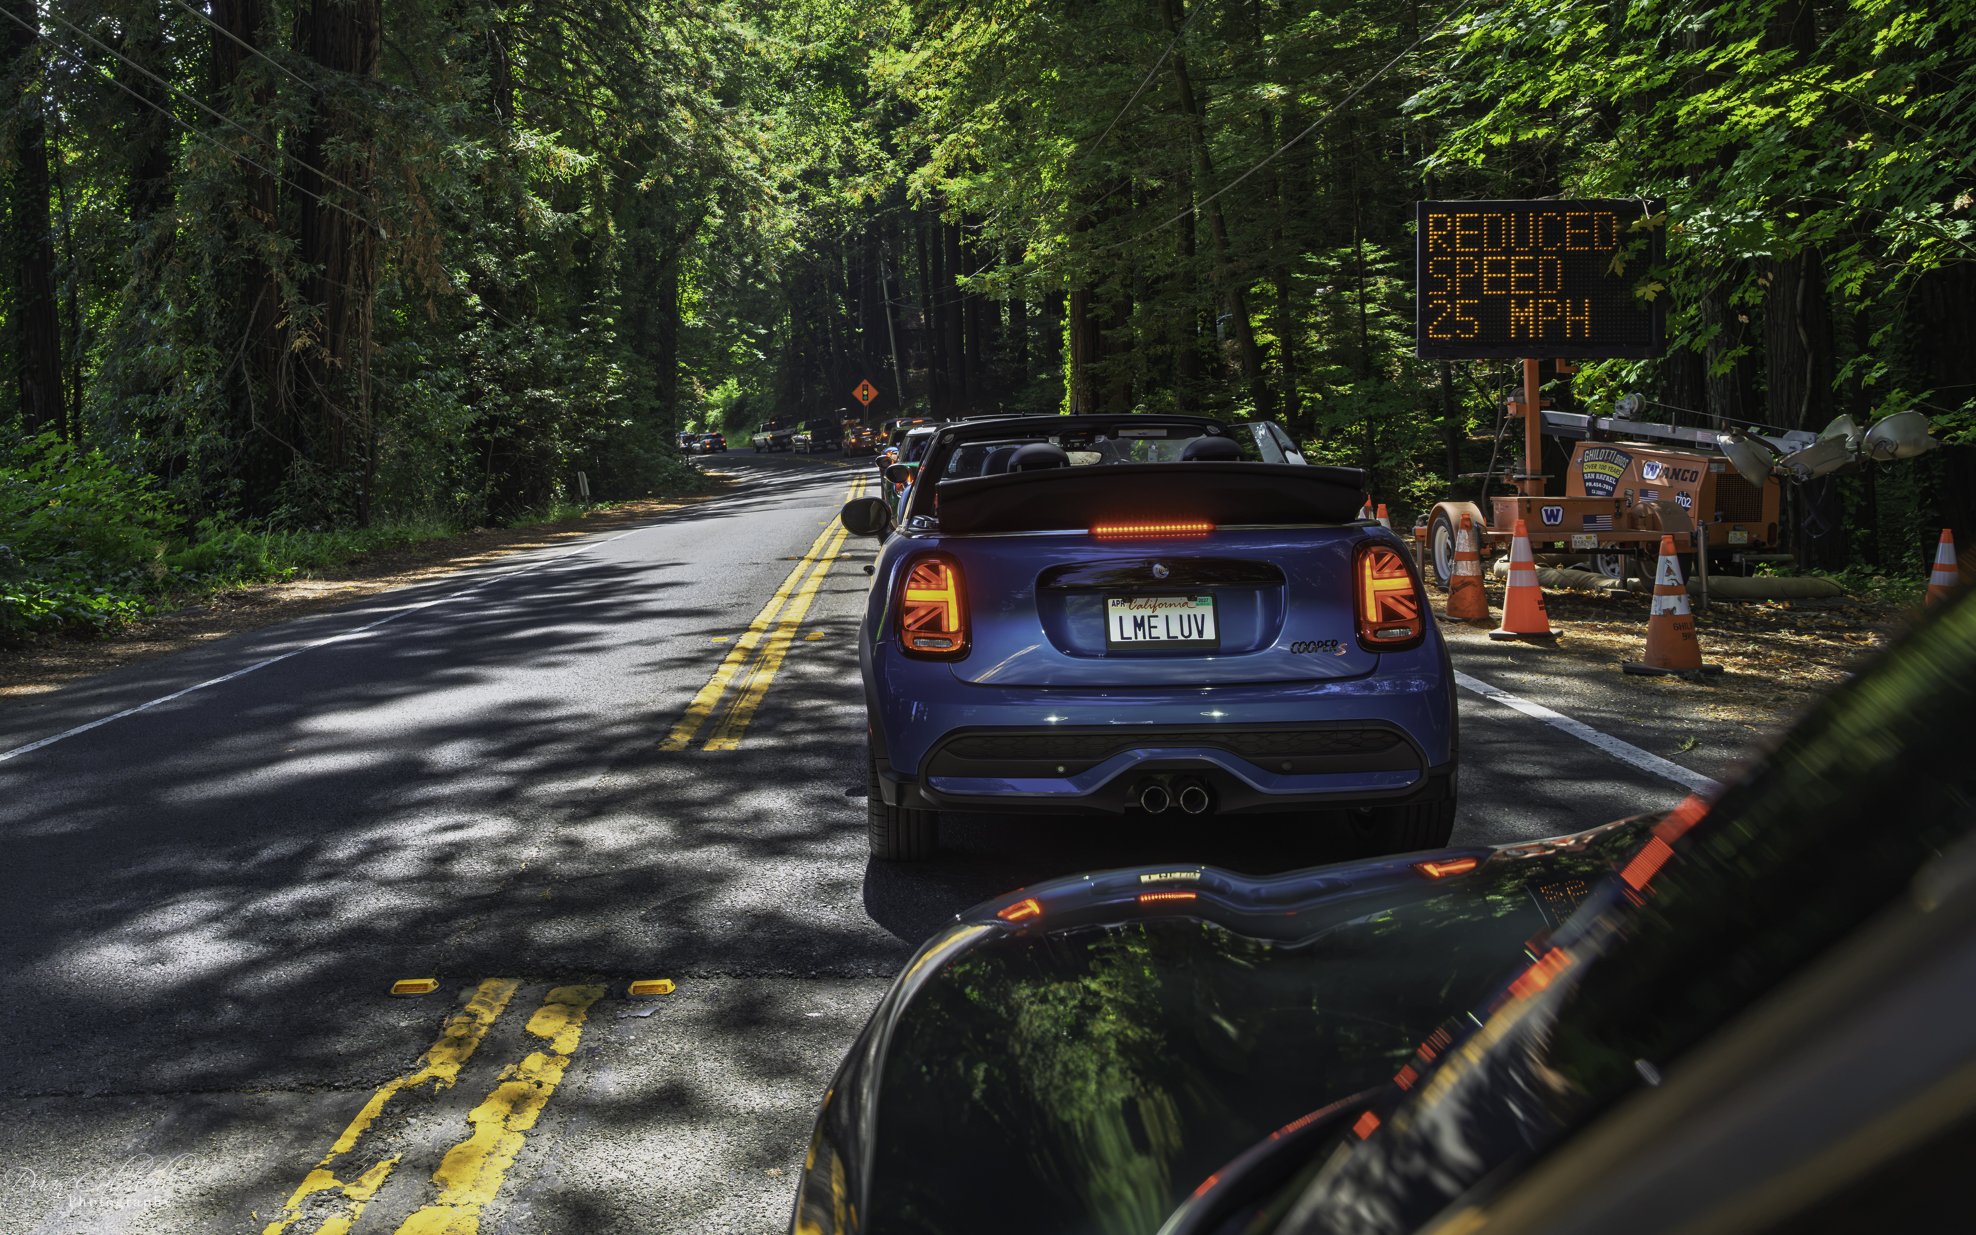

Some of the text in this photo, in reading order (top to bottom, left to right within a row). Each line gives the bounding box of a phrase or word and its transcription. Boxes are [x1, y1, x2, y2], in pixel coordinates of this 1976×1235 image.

[1428, 213, 1618, 252] REDUCED
[1428, 256, 1562, 295] SPEED
[1428, 299, 1591, 338] 25 MPH
[1584, 449, 1617, 462] GHILOTTI
[1596, 473, 1616, 485] RAFAEL
[1675, 495, 1692, 508] 1702
[1543, 508, 1561, 523] W
[1128, 599, 1197, 613] California
[1119, 613, 1205, 640] LME LUV
[1291, 639, 1348, 656] COOPER S
